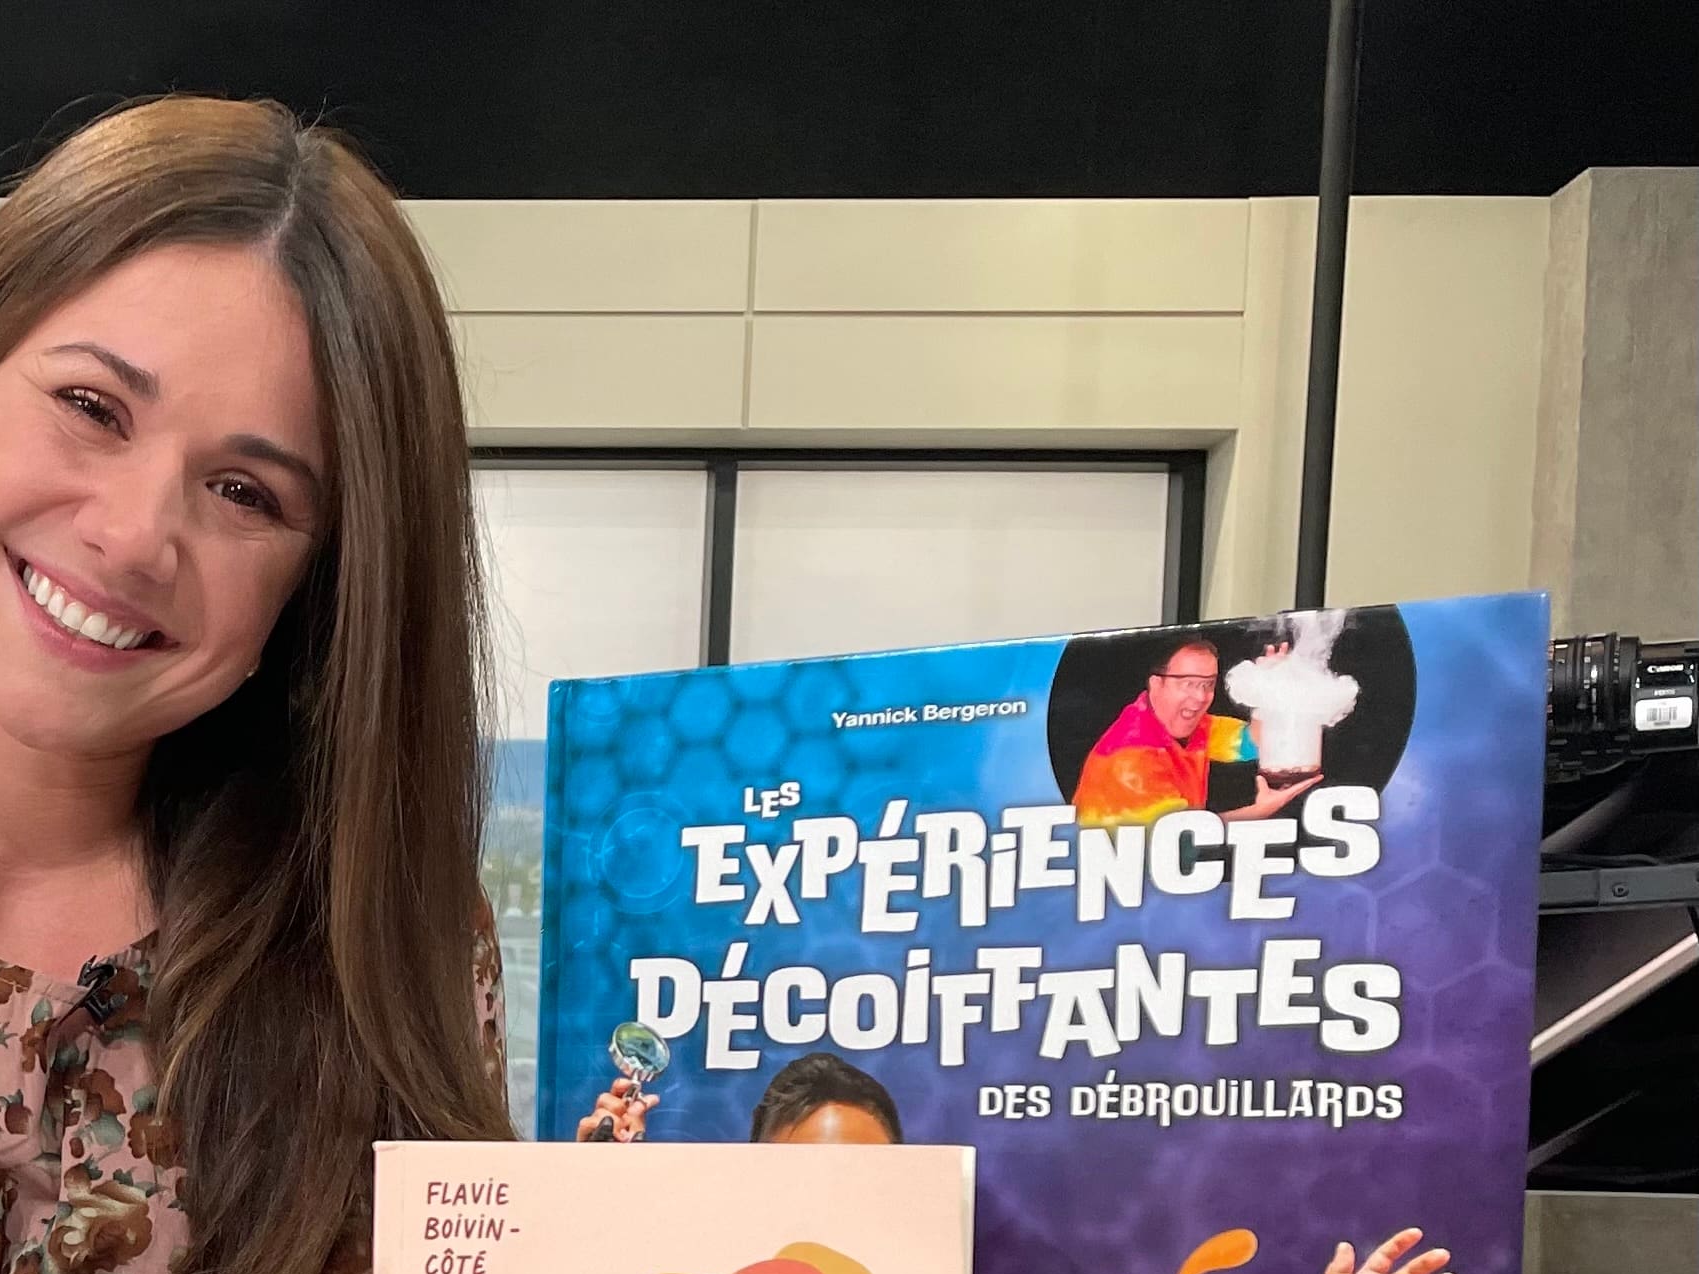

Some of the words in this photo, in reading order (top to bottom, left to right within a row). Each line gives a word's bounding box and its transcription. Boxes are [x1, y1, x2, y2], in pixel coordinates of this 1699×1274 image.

[832, 706, 918, 729] Yannick
[923, 700, 1027, 722] Bergeron
[744, 781, 801, 819] LES
[681, 784, 1381, 934] EXPÉRIENCES
[630, 938, 1402, 1070] DÉCOIFFANTES
[978, 1083, 1051, 1119] DES
[1071, 1068, 1403, 1128] DÉBROUILLARDS
[426, 1177, 510, 1207] FLAVIE
